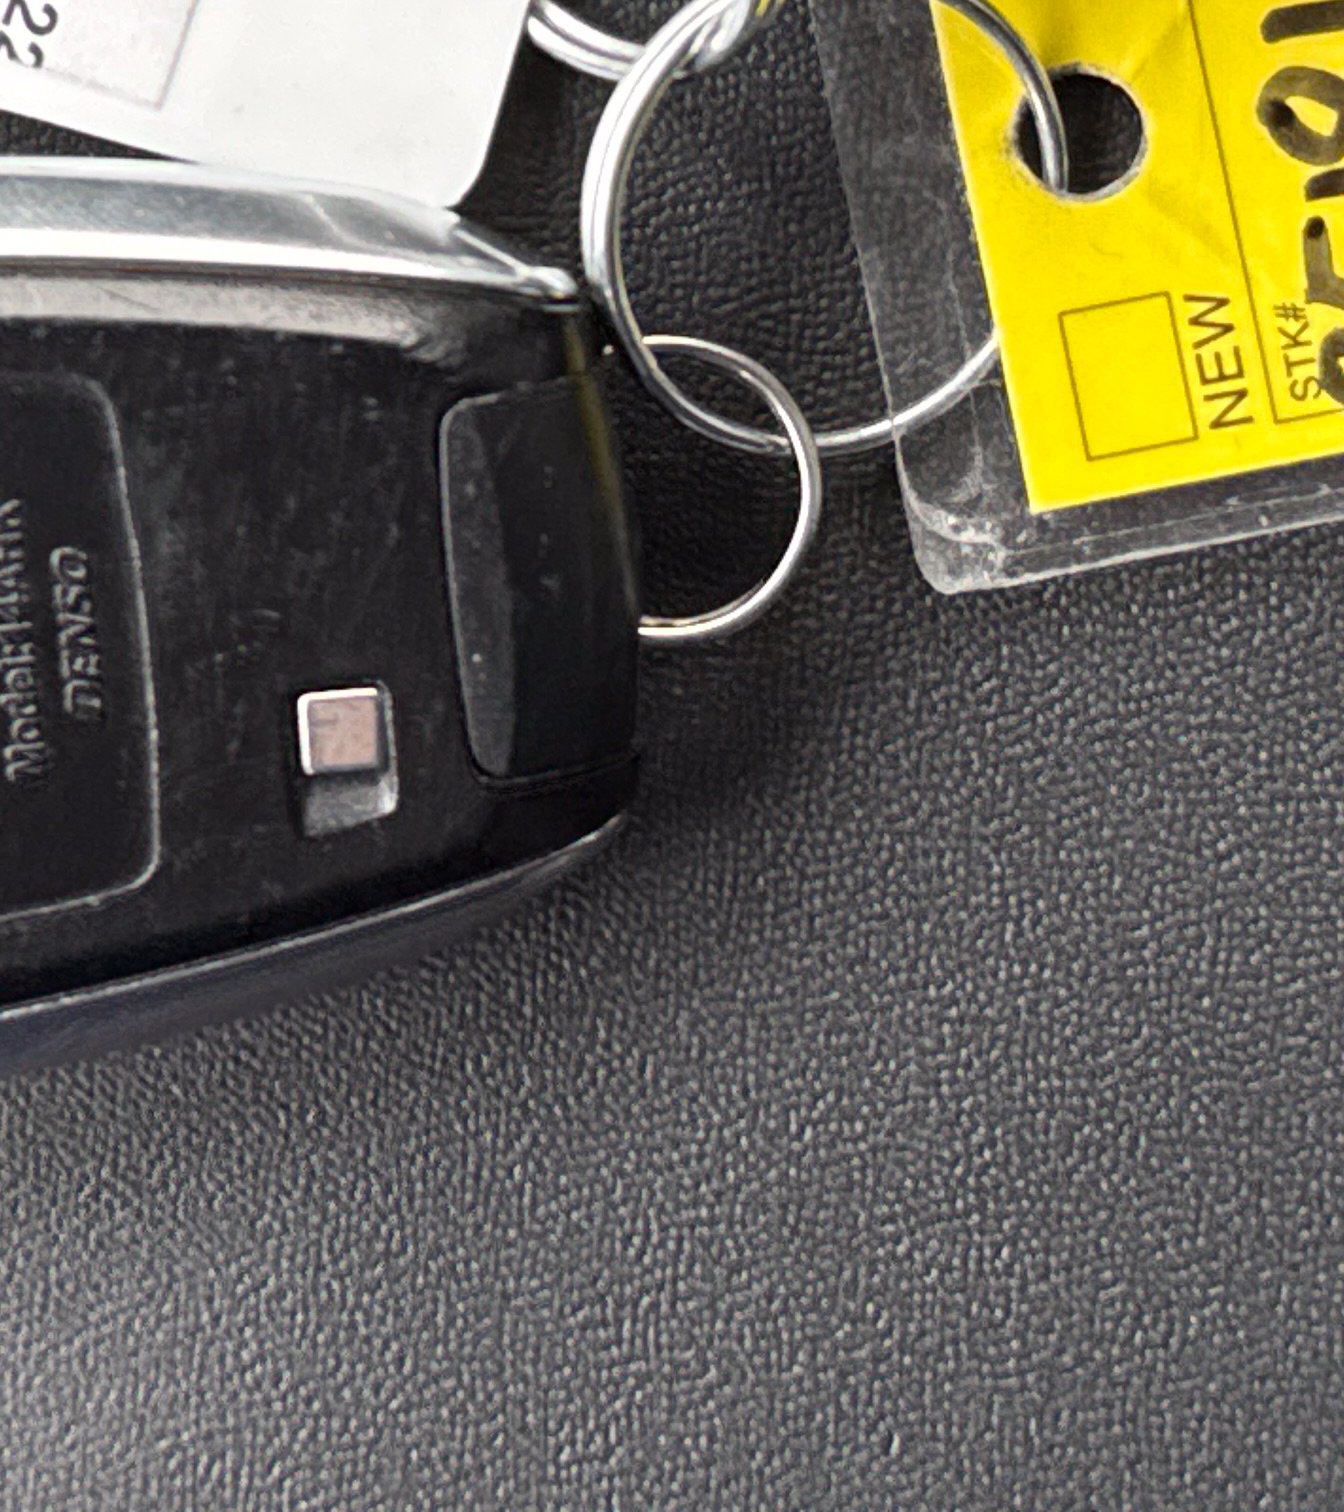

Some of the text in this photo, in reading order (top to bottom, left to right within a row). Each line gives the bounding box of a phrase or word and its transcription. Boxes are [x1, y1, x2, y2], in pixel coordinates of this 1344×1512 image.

[1183, 293, 1255, 431] NEW
[1273, 302, 1321, 401] STK#
[49, 545, 105, 719] DENSO
